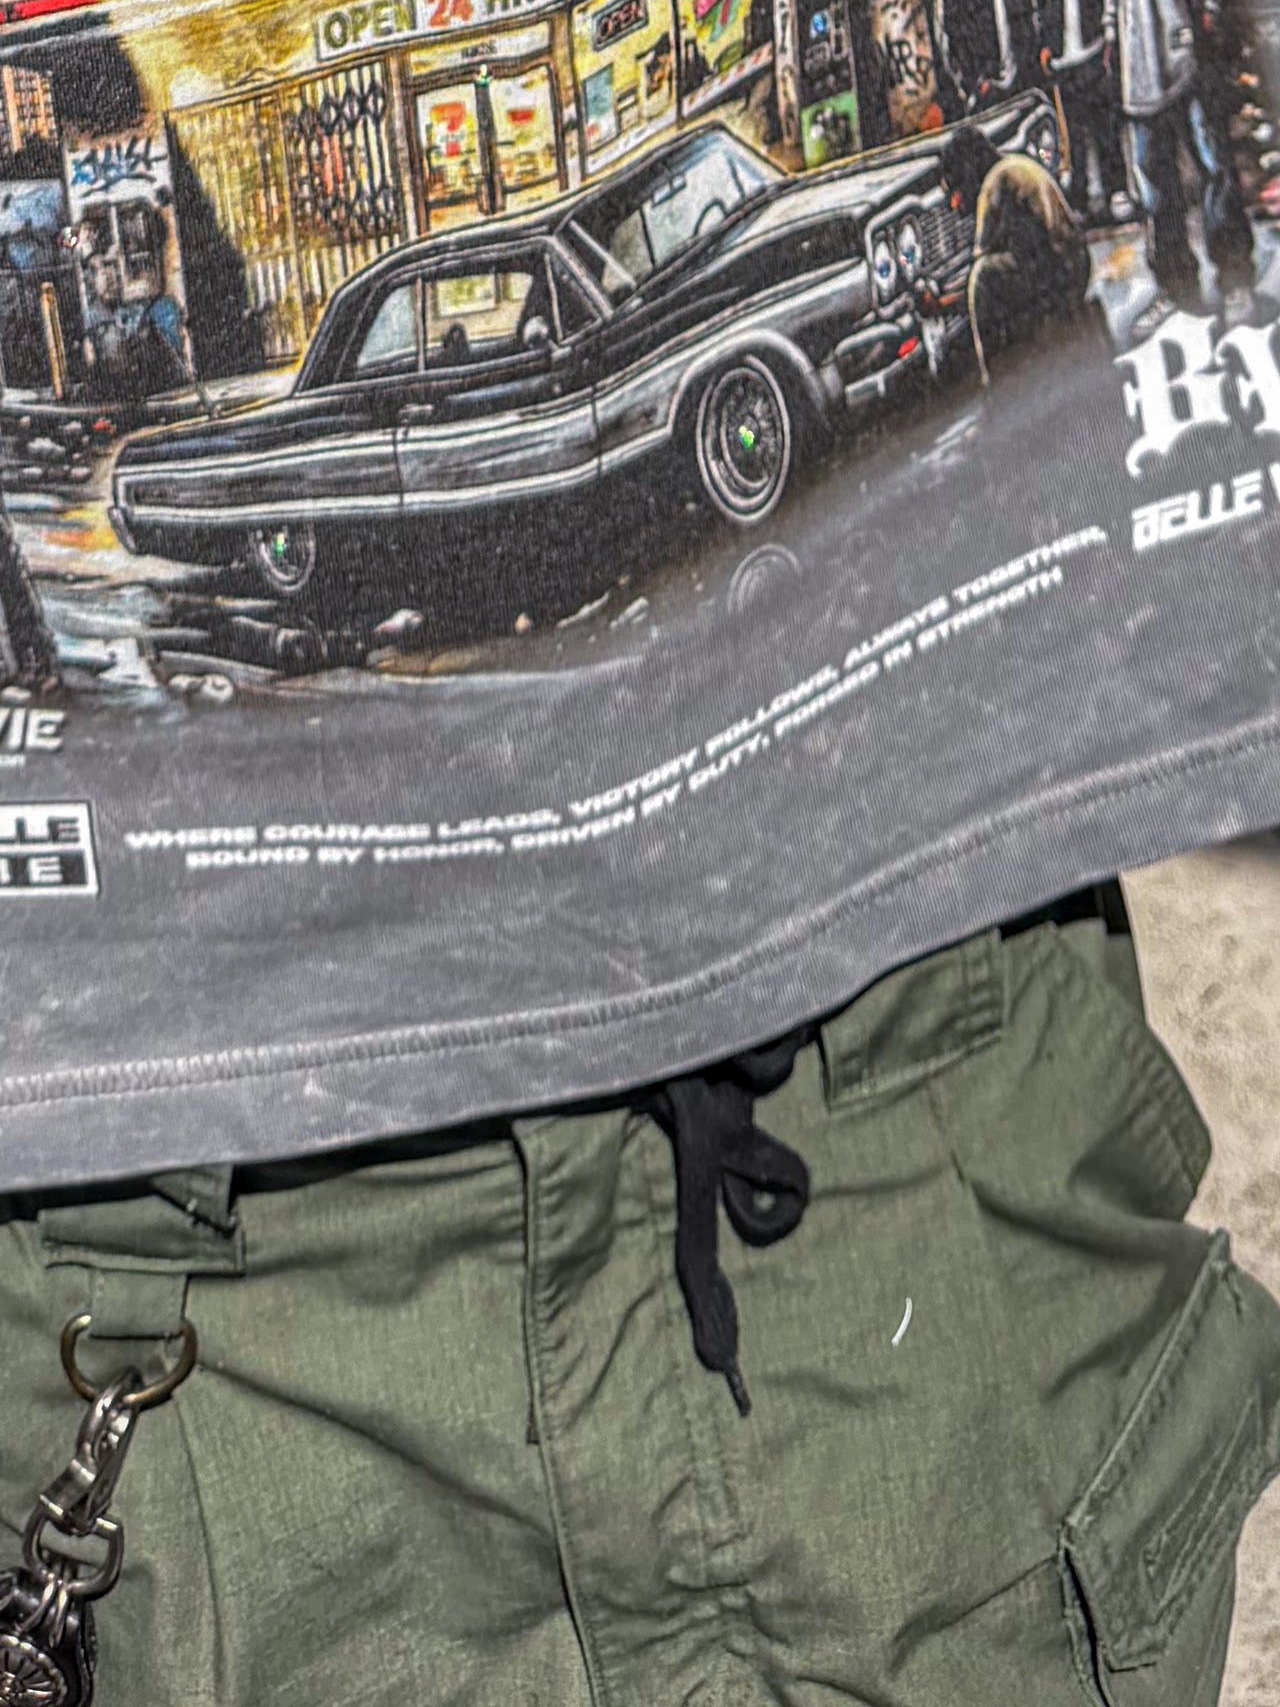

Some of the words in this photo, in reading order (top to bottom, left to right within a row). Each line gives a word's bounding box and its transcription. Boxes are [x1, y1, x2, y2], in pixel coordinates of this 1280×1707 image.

[1131, 469, 1264, 552] BELLE
[124, 826, 257, 850] WHERE
[263, 823, 431, 844] COURAGE
[437, 808, 562, 838] LEADS,
[569, 745, 698, 817] VICTORY
[705, 664, 839, 756] FOLLOWS,
[843, 595, 950, 669] ALWAYS
[951, 524, 1108, 604] TOGETHER,
[185, 845, 310, 871] BOUND
[317, 844, 365, 866] BY
[373, 837, 506, 864] HONOR,
[511, 805, 635, 851] DRIVEN
[640, 783, 680, 817] BY
[688, 732, 770, 792] DUTY,
[773, 660, 880, 737] FORGED
[883, 640, 913, 671] IN
[917, 564, 1064, 651] STRENGTH
